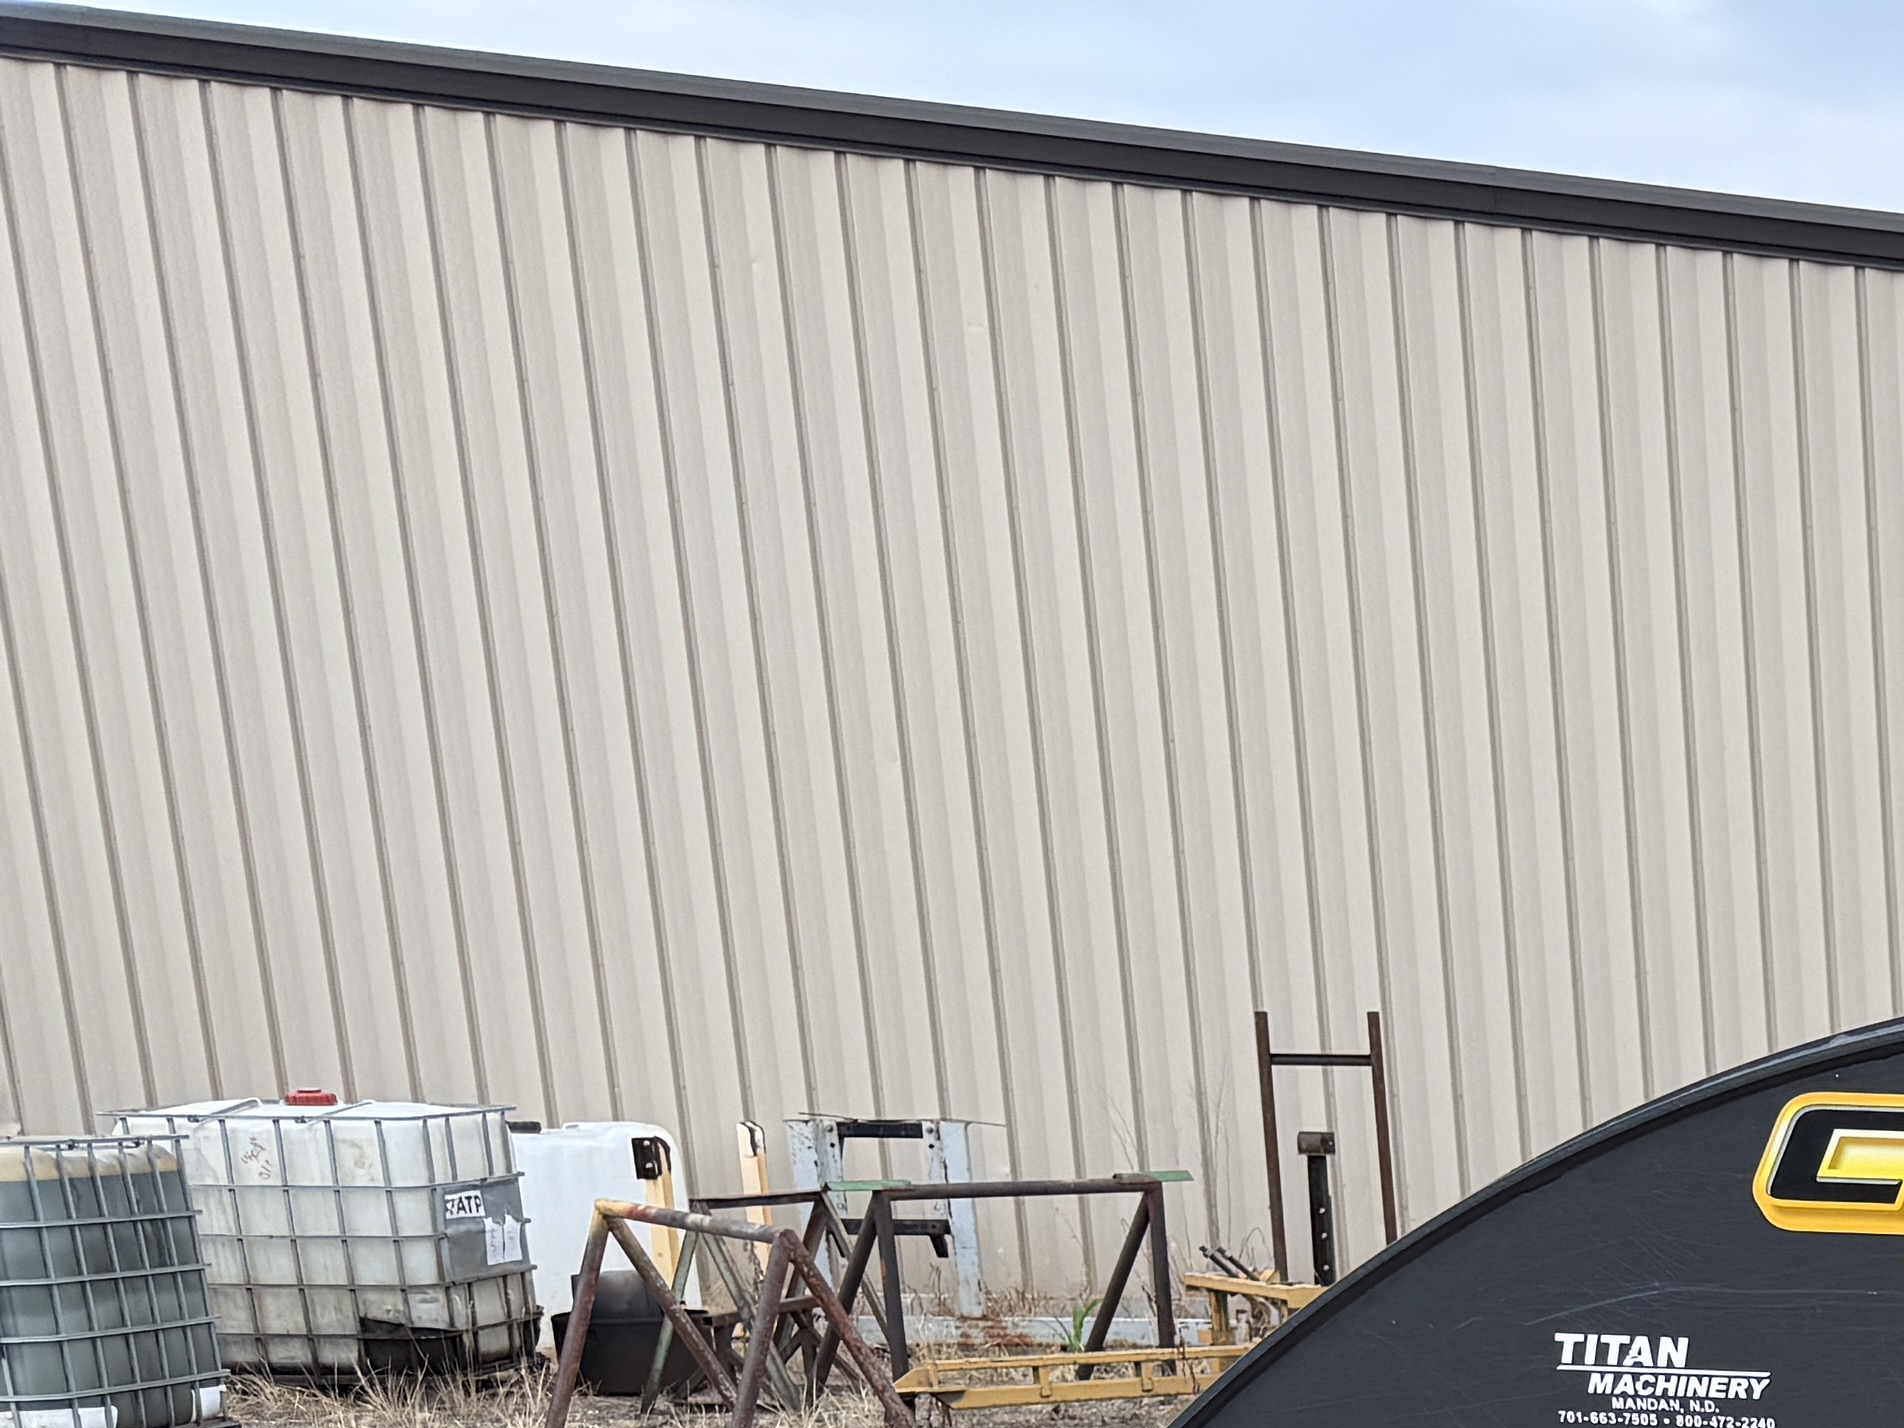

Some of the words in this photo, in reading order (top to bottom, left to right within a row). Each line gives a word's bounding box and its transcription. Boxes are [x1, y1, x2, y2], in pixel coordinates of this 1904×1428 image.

[1554, 1332, 1689, 1368] TITAN
[1588, 1373, 1770, 1400] MACHINERY
[1611, 1397, 1684, 1413] MANDAN,
[1690, 1400, 1720, 1413] N.D.
[1558, 1411, 1658, 1427] 701-663-7505
